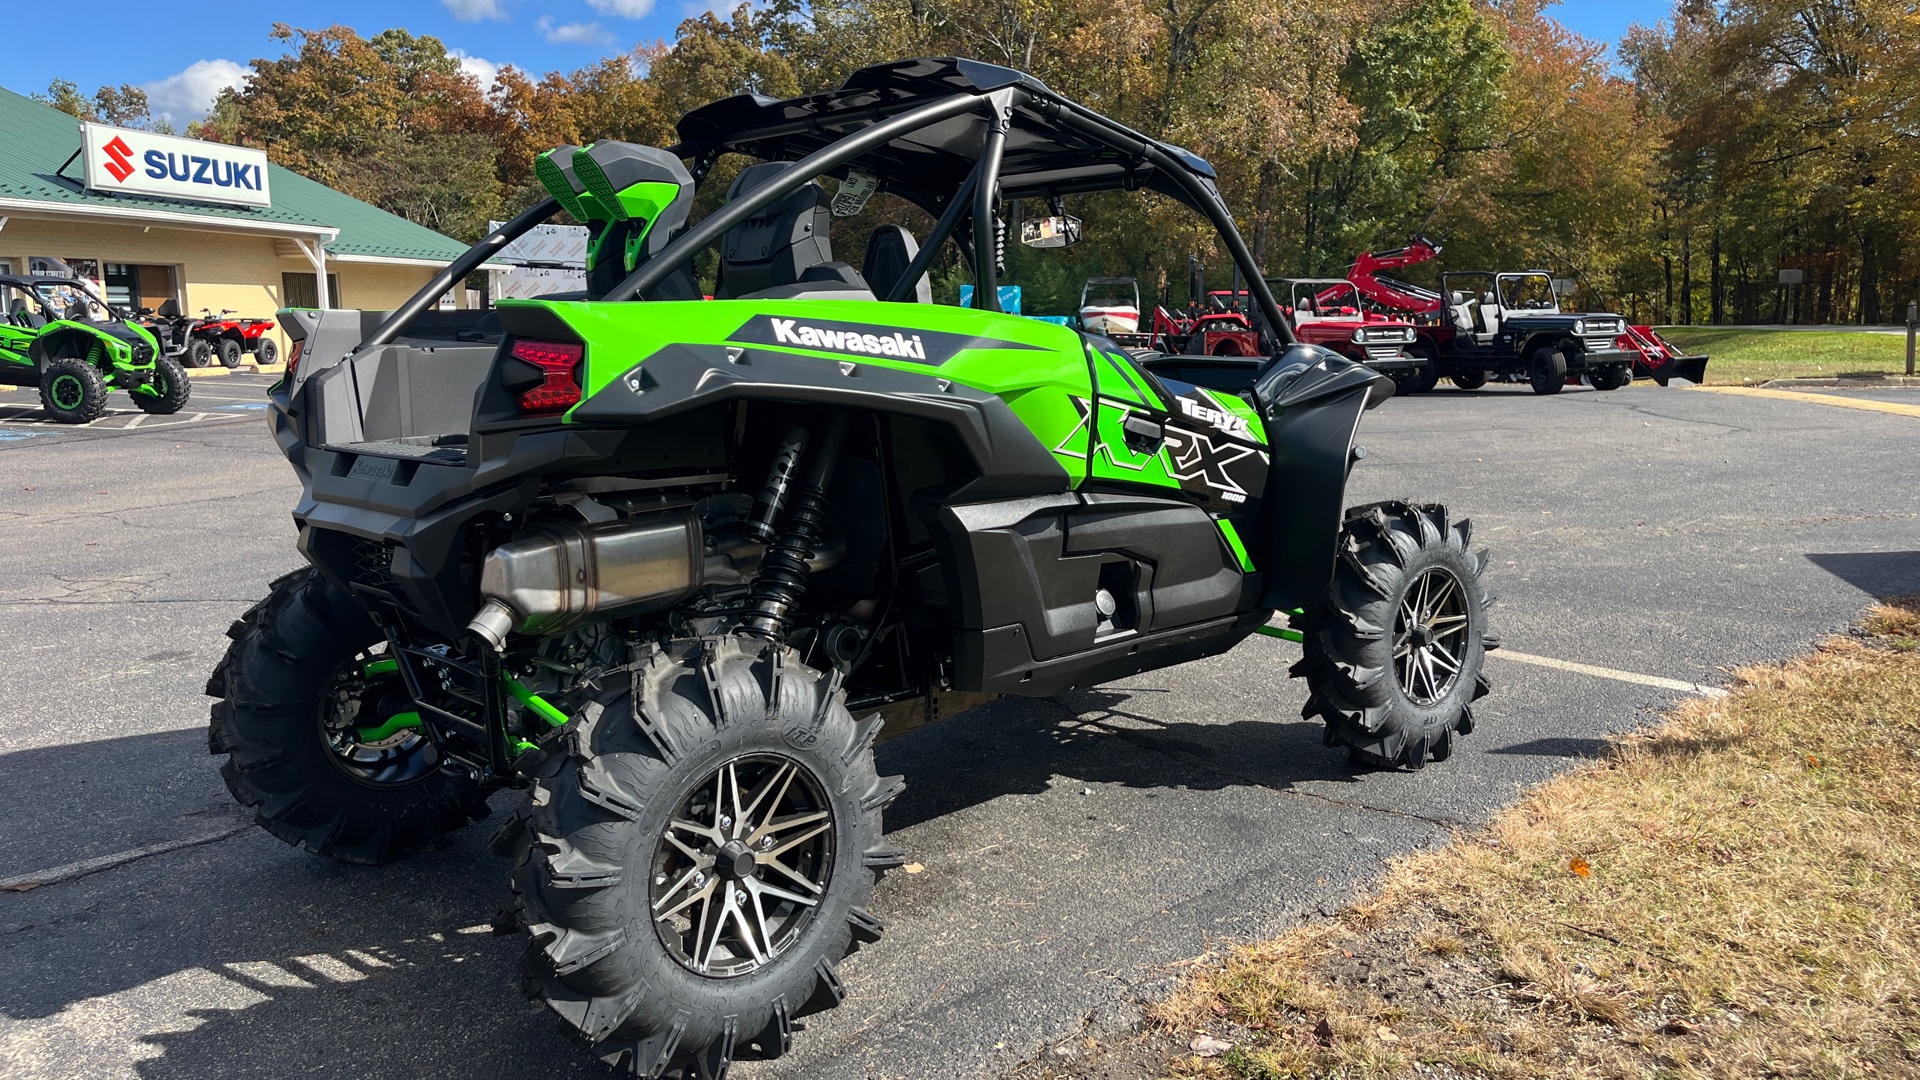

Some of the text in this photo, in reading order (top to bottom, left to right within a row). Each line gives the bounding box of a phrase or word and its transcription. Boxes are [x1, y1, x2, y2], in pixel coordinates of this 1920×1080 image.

[144, 149, 262, 191] SUZUKI
[770, 317, 926, 360] Kawasaki
[352, 459, 396, 479] Kawasaki
[764, 440, 803, 495] FOX
[1221, 491, 1246, 503] 1000
